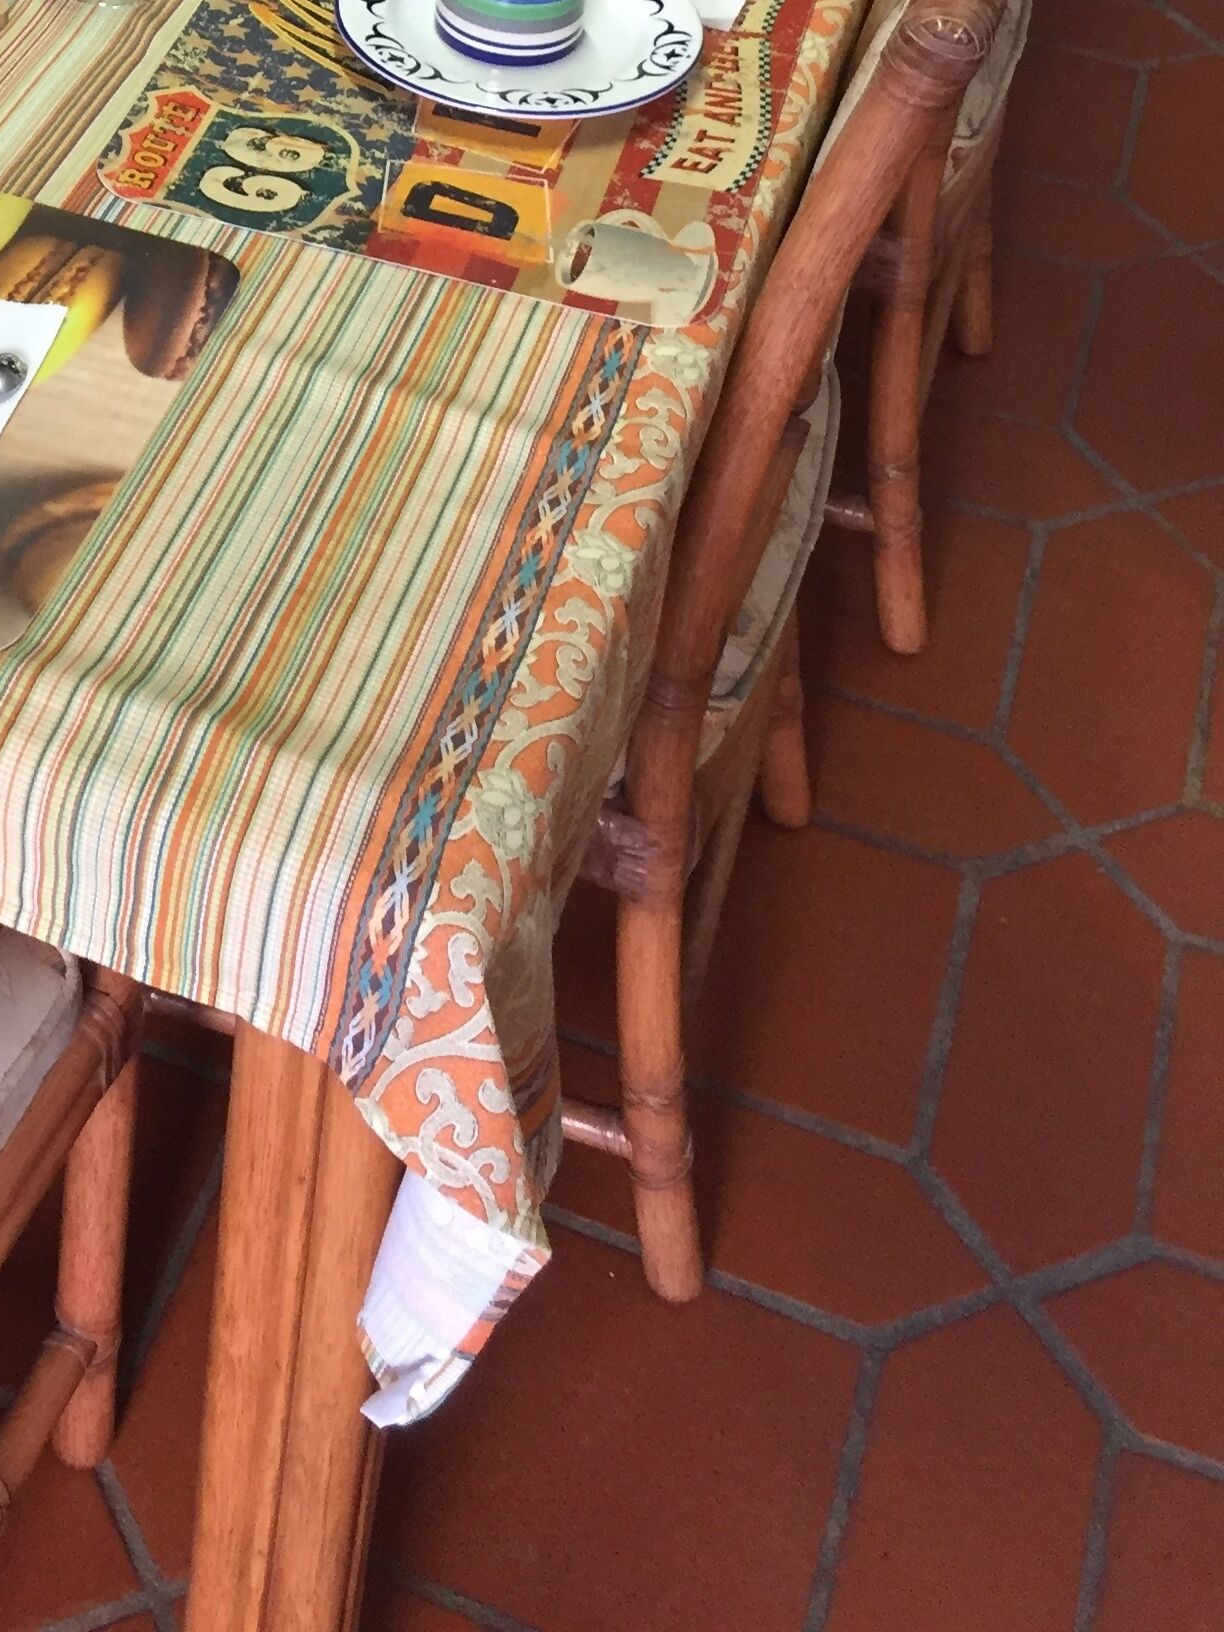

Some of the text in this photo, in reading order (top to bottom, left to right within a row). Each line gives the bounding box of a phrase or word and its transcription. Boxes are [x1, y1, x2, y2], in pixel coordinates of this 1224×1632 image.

[118, 101, 200, 190] ROUTE
[198, 124, 326, 213] 66
[670, 129, 736, 173] EAT
